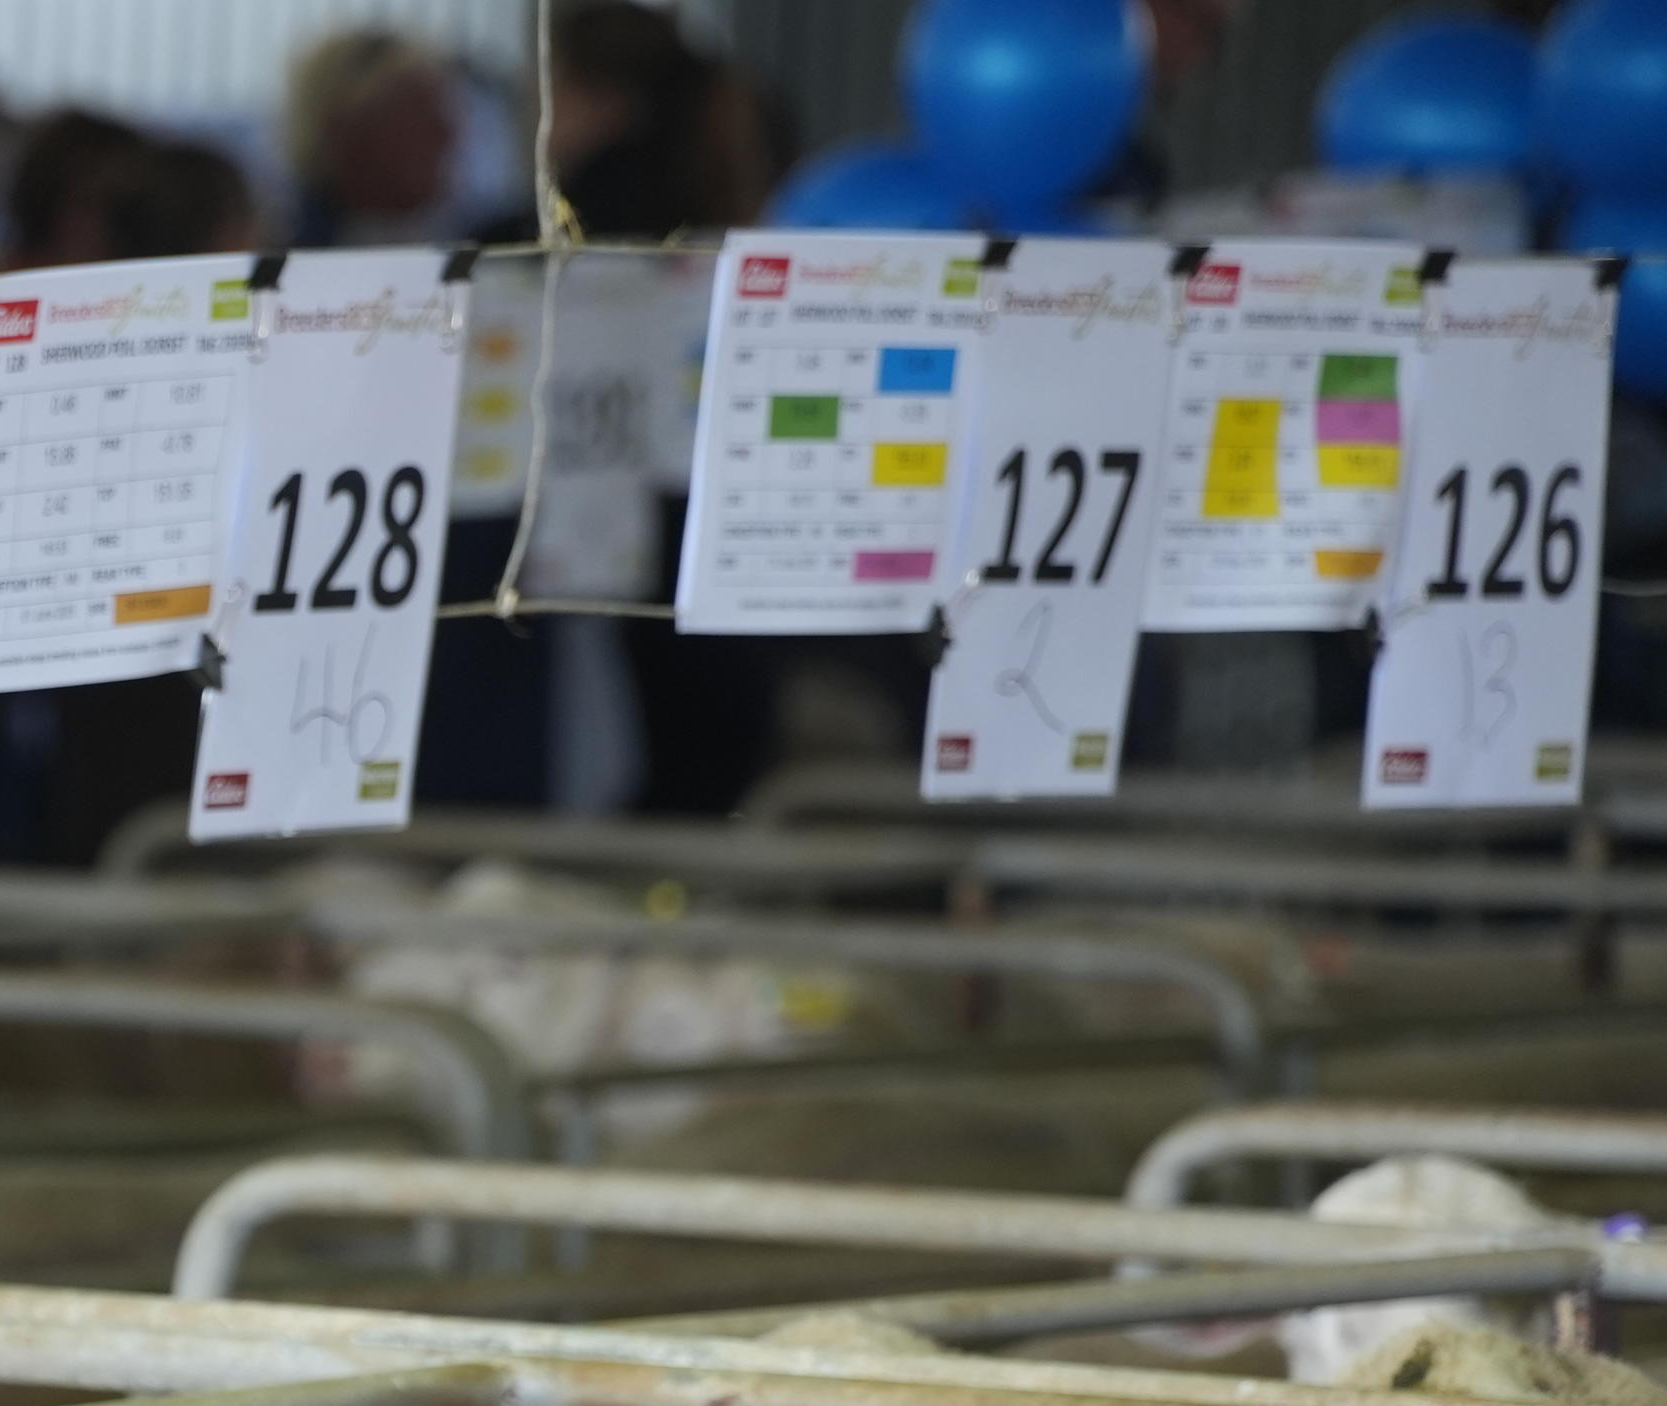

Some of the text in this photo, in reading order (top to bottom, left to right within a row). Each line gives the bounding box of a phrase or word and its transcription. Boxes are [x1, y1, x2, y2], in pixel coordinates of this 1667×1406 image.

[252, 464, 427, 616] 128
[981, 446, 1143, 586] 127
[1428, 461, 1584, 600] 126
